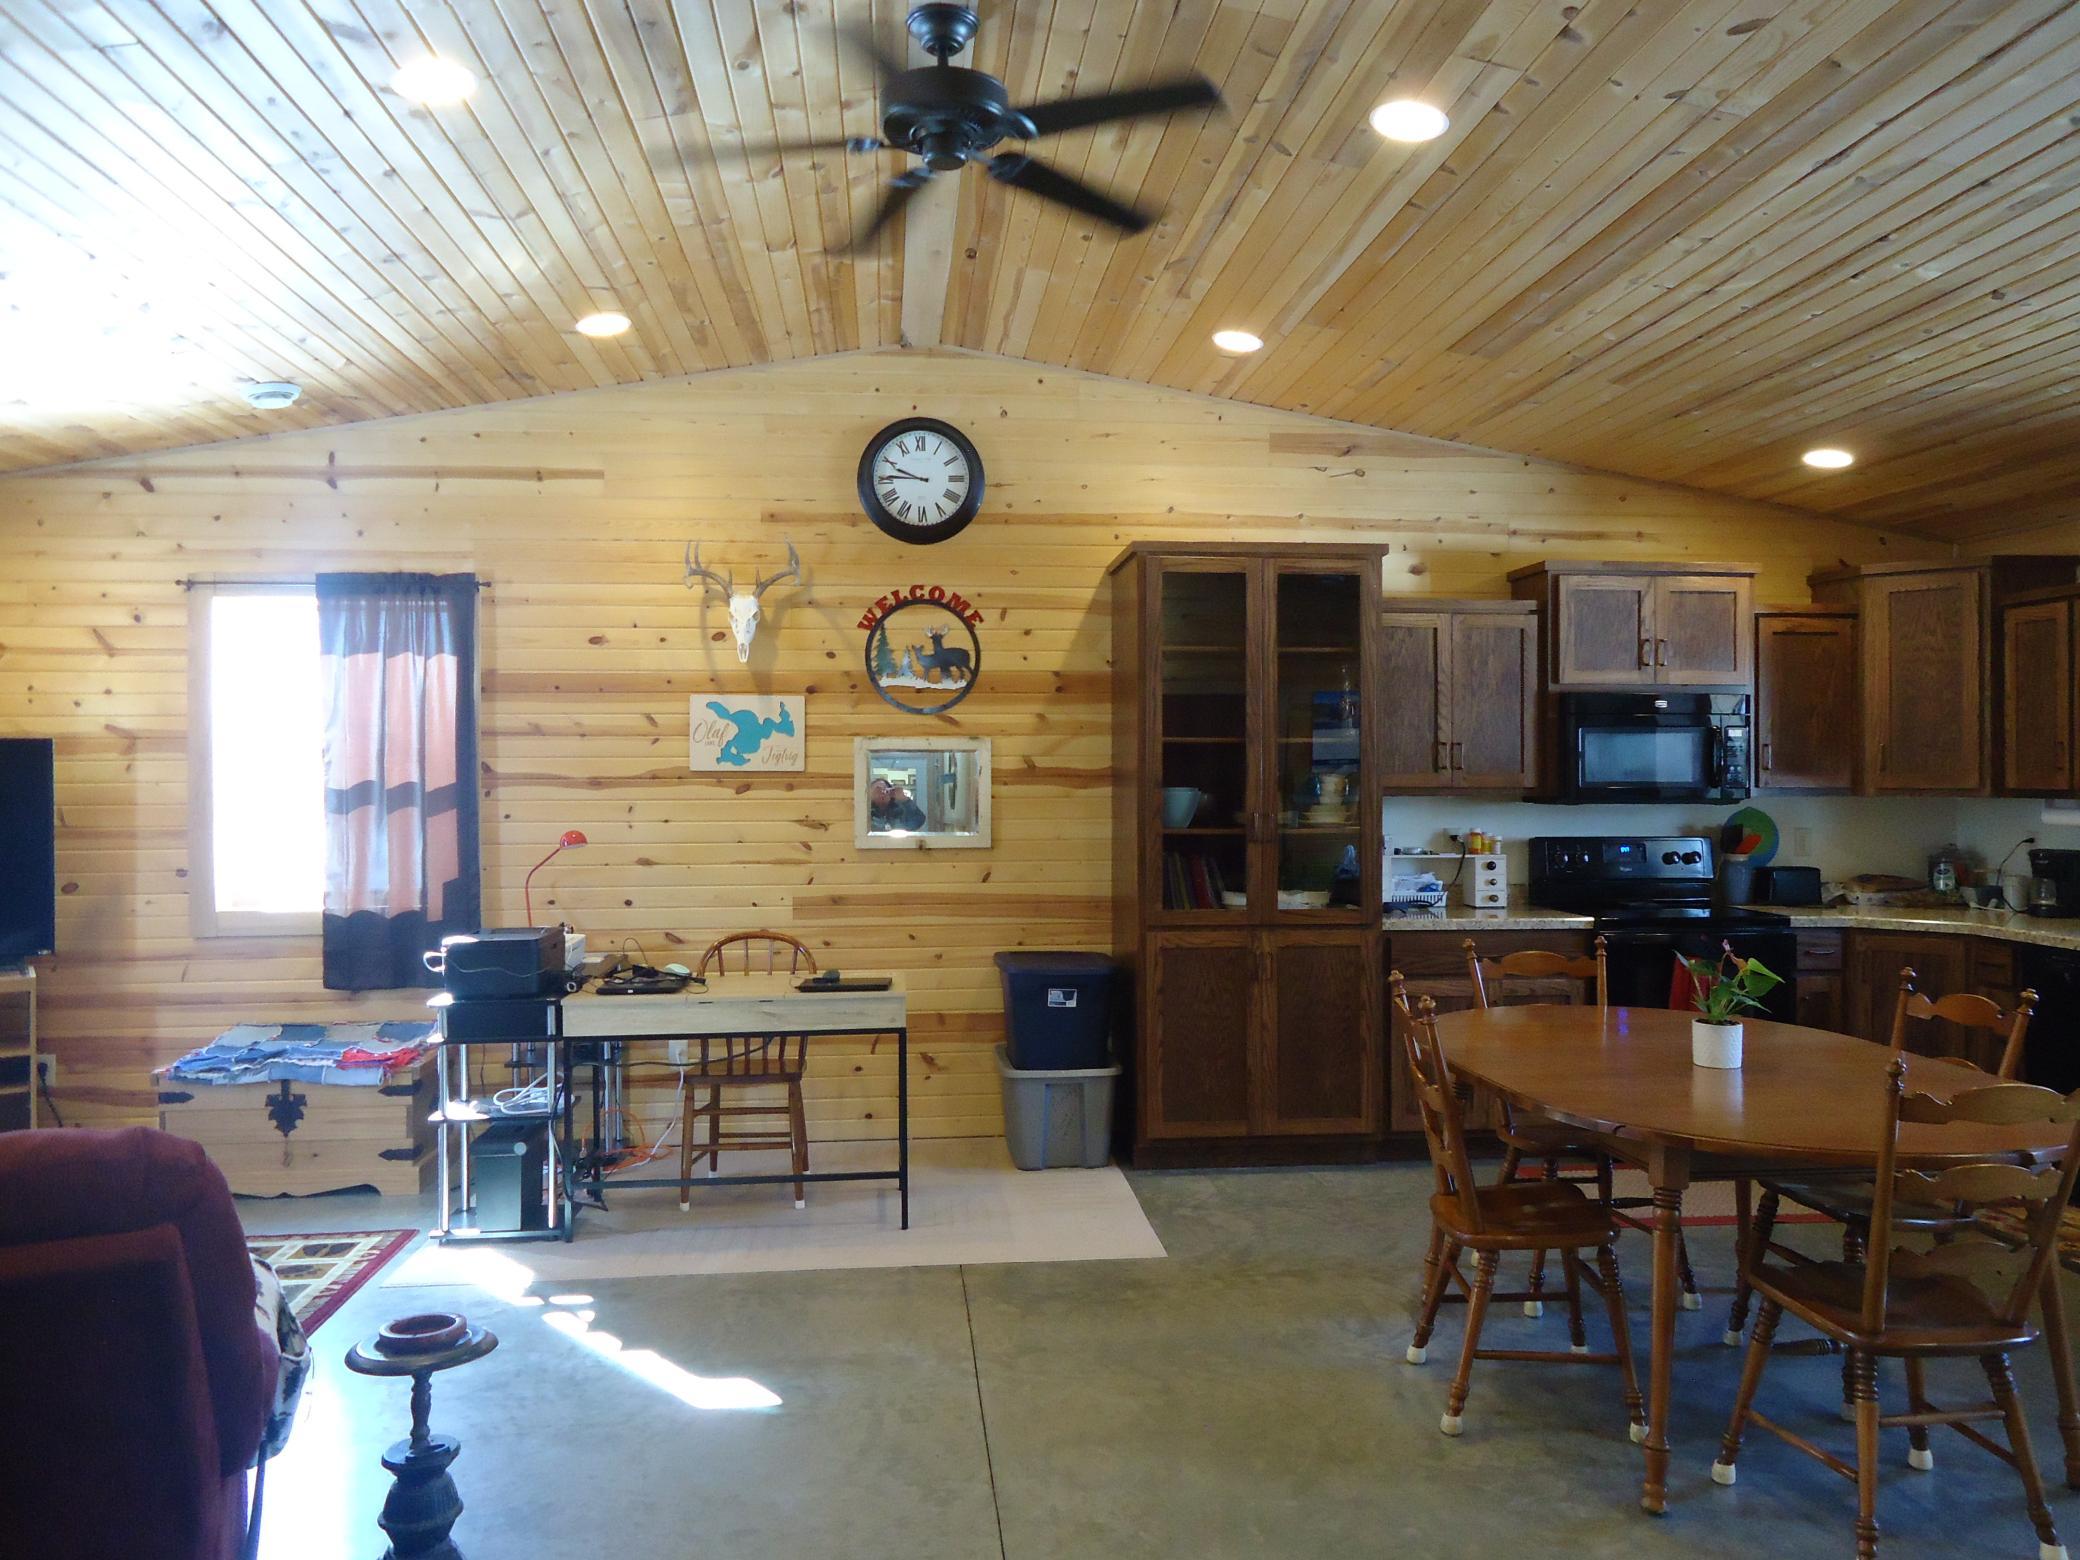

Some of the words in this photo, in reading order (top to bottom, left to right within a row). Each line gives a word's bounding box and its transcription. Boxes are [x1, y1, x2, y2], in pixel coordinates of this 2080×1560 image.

[896, 440, 910, 457] XI
[915, 436, 926, 451] XII
[944, 456, 959, 467] II
[948, 475, 964, 483] III
[881, 488, 900, 507] VIII
[896, 500, 912, 519] VII
[918, 505, 928, 523] VI
[934, 502, 947, 518] V
[856, 584, 985, 631] WELCOME
[692, 718, 730, 747] Olaf
